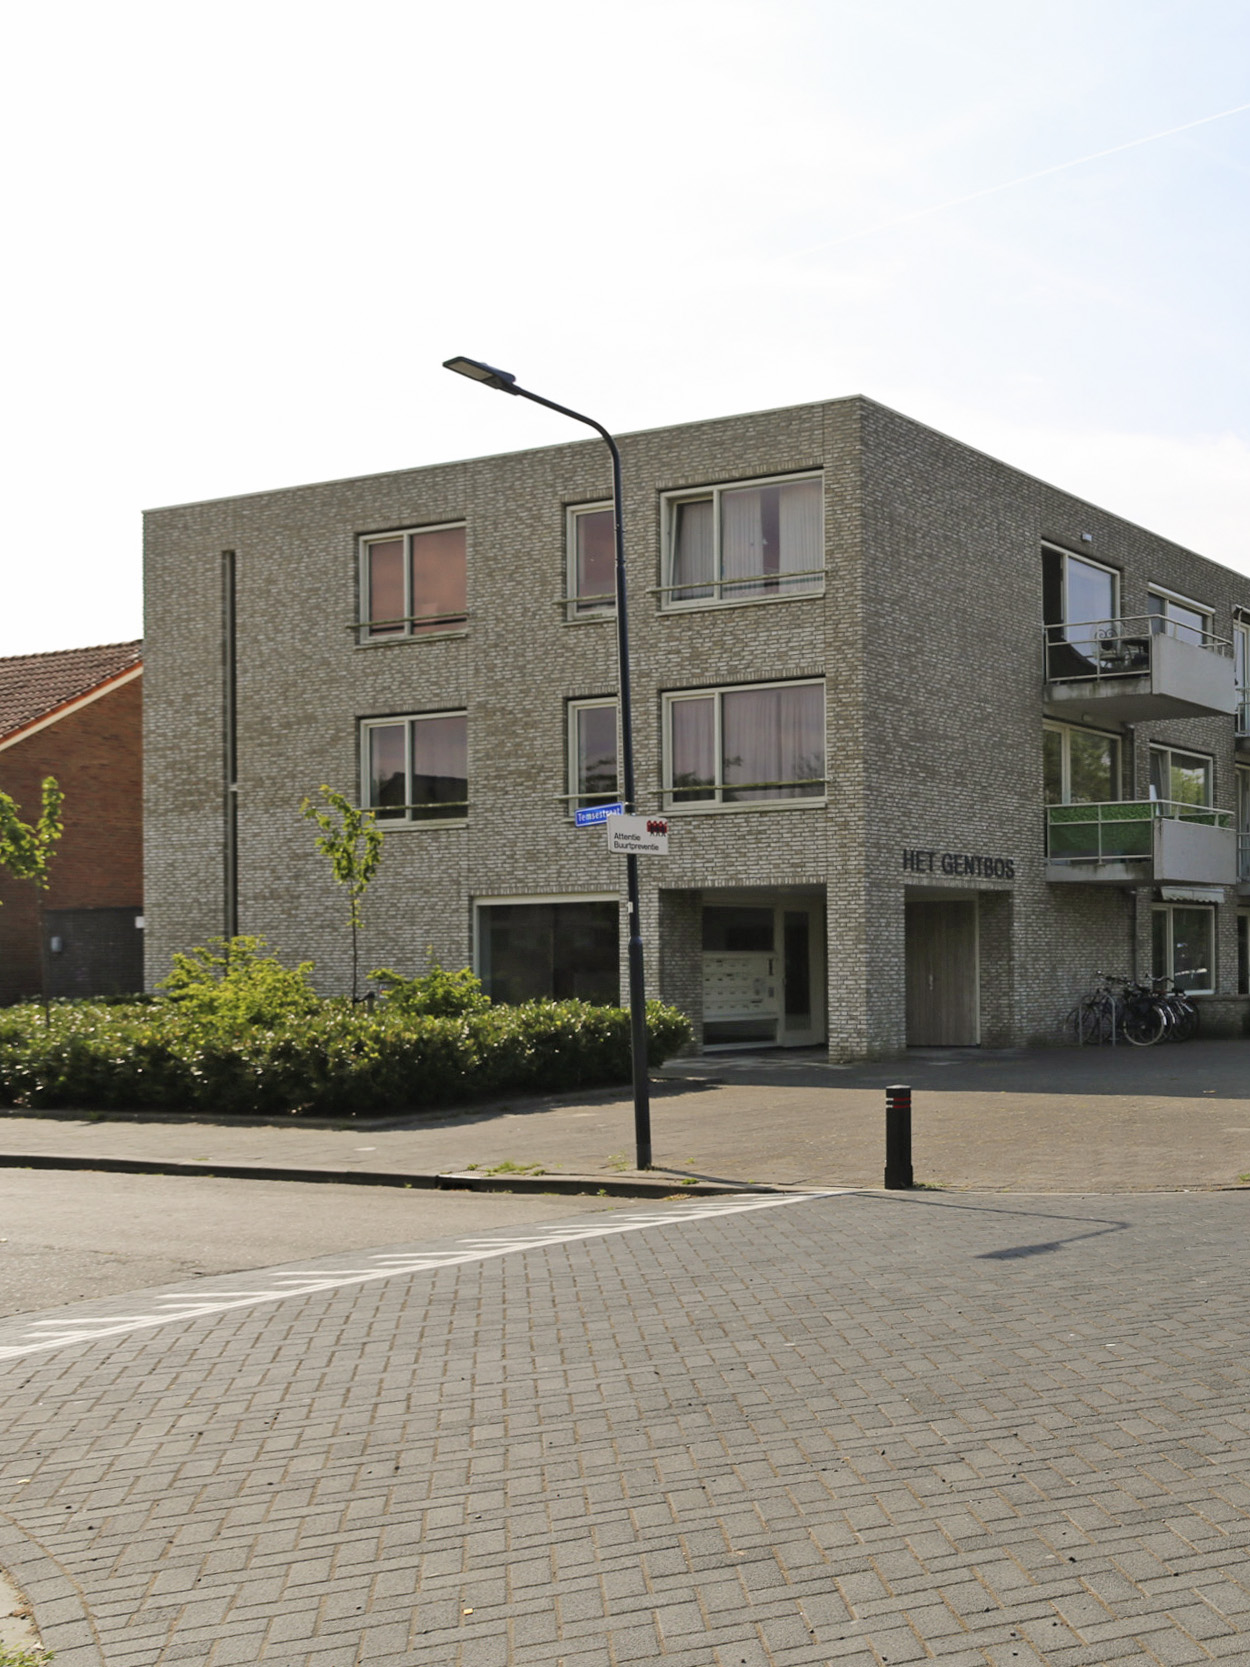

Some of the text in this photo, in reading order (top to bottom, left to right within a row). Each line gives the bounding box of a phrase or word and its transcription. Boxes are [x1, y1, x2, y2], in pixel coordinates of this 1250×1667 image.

[614, 832, 641, 841] Attentie
[613, 840, 659, 851] Buurtpreventie
[902, 849, 1015, 879] HET GENTBOS
